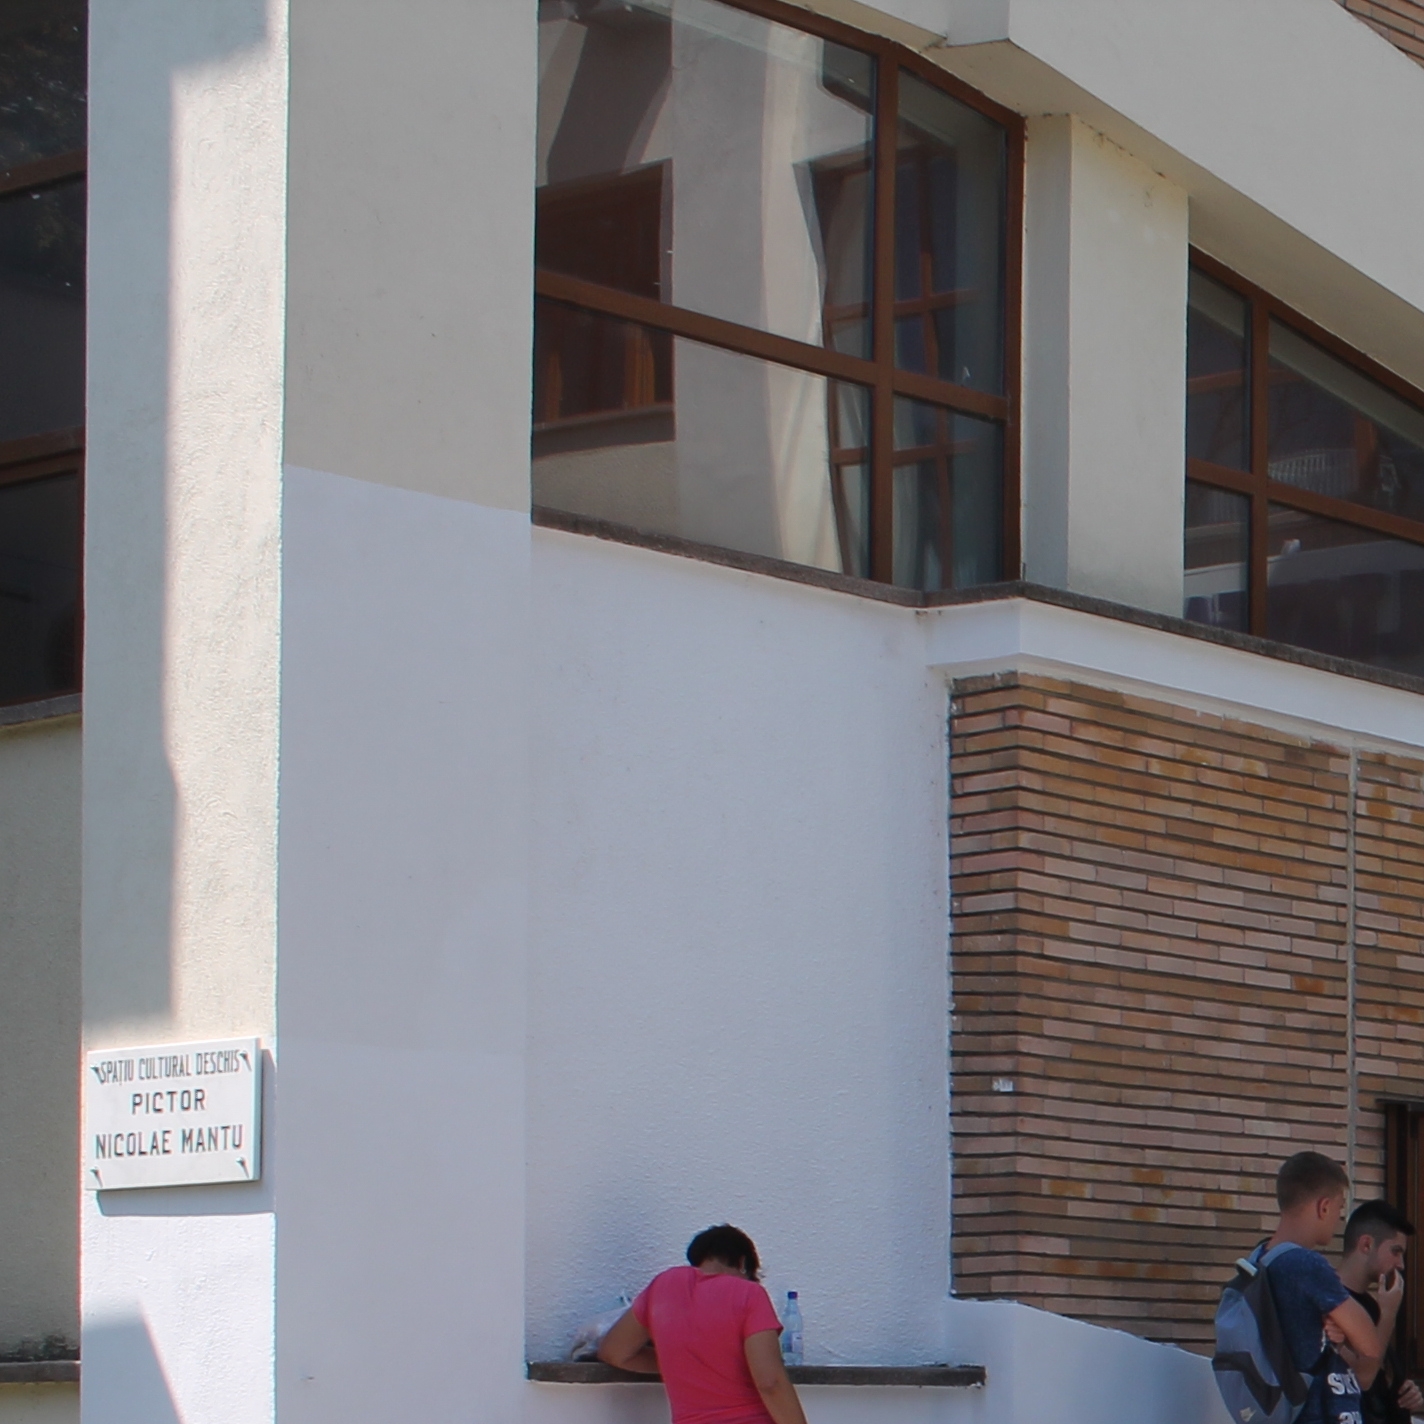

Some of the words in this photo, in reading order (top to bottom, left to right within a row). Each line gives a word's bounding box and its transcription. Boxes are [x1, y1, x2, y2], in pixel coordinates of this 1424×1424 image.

[100, 1057, 134, 1086] SPAȚIU
[138, 1053, 191, 1081] CULTURAL
[195, 1049, 241, 1076] DESCHIS
[132, 1088, 206, 1115] PICTOR
[95, 1130, 172, 1160] NICOLAE
[181, 1124, 244, 1154] MANTU
